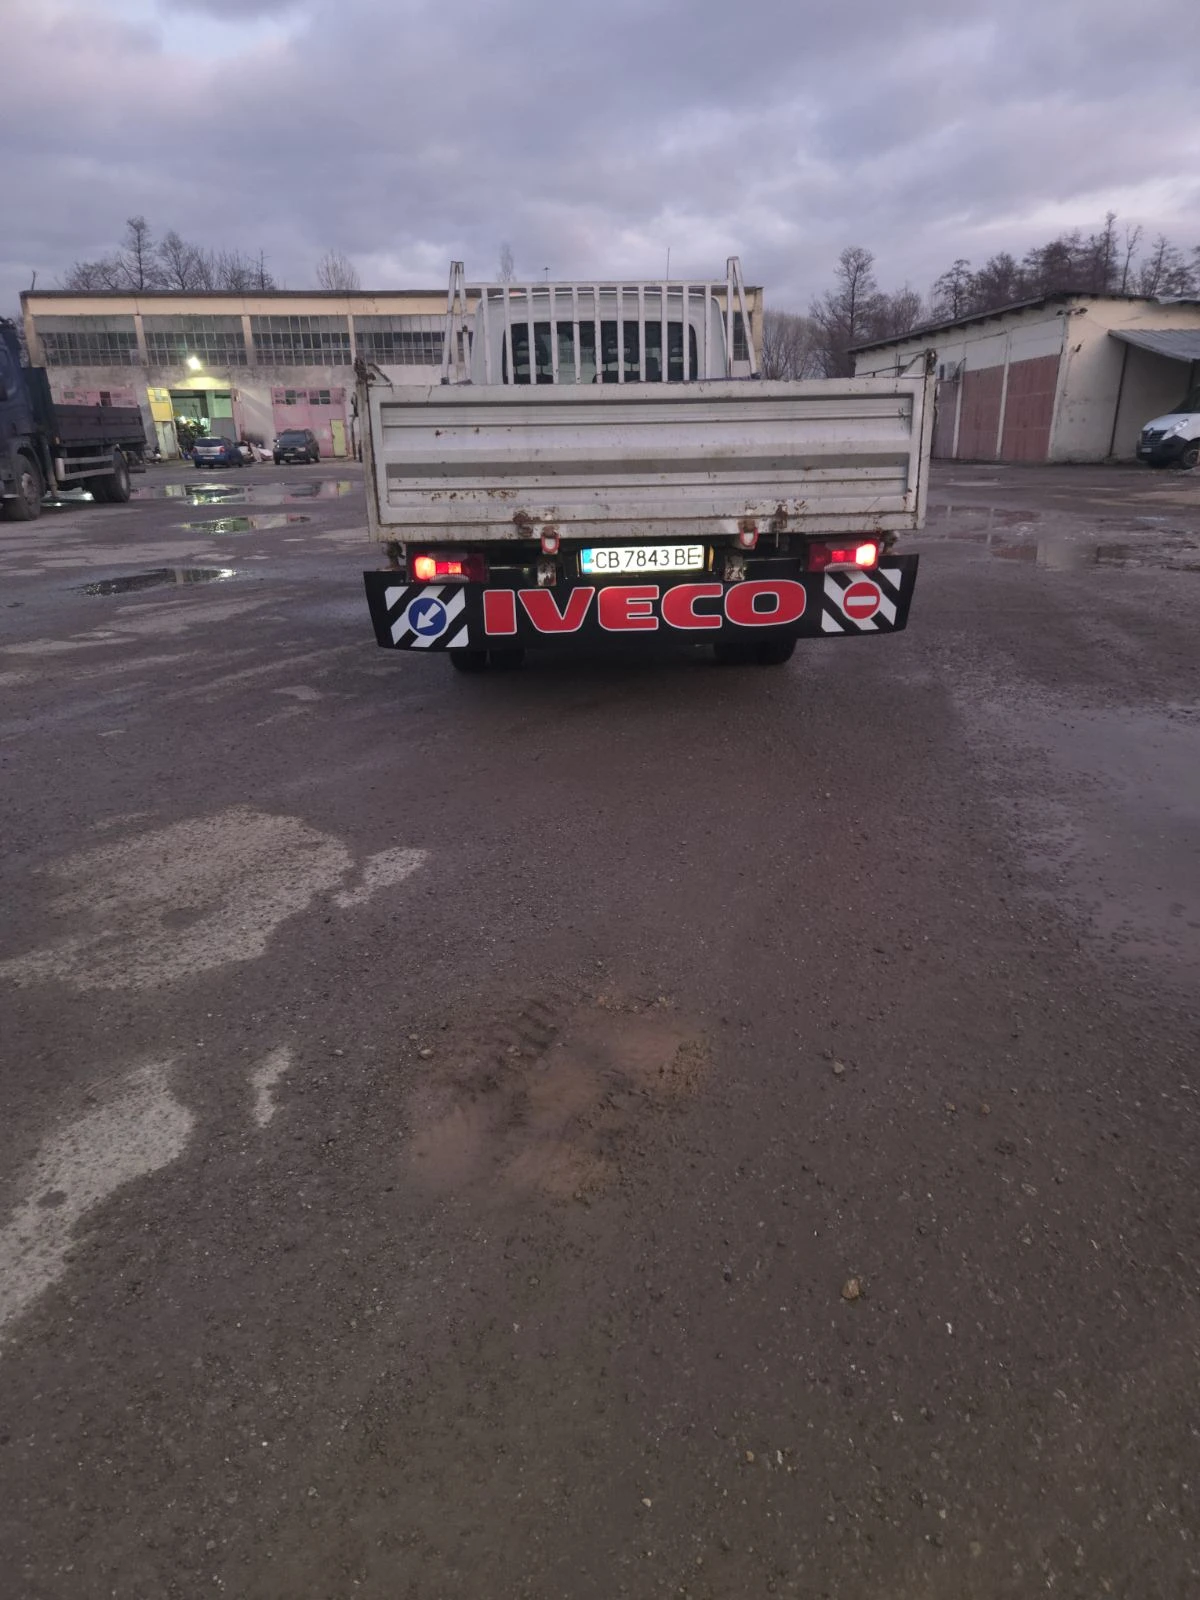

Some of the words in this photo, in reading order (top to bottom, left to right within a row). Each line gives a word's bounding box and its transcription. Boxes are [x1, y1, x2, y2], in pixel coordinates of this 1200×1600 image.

[595, 551, 620, 569] CB
[624, 549, 670, 568] 7843
[674, 547, 699, 566] BE
[483, 580, 806, 635] IVECO
